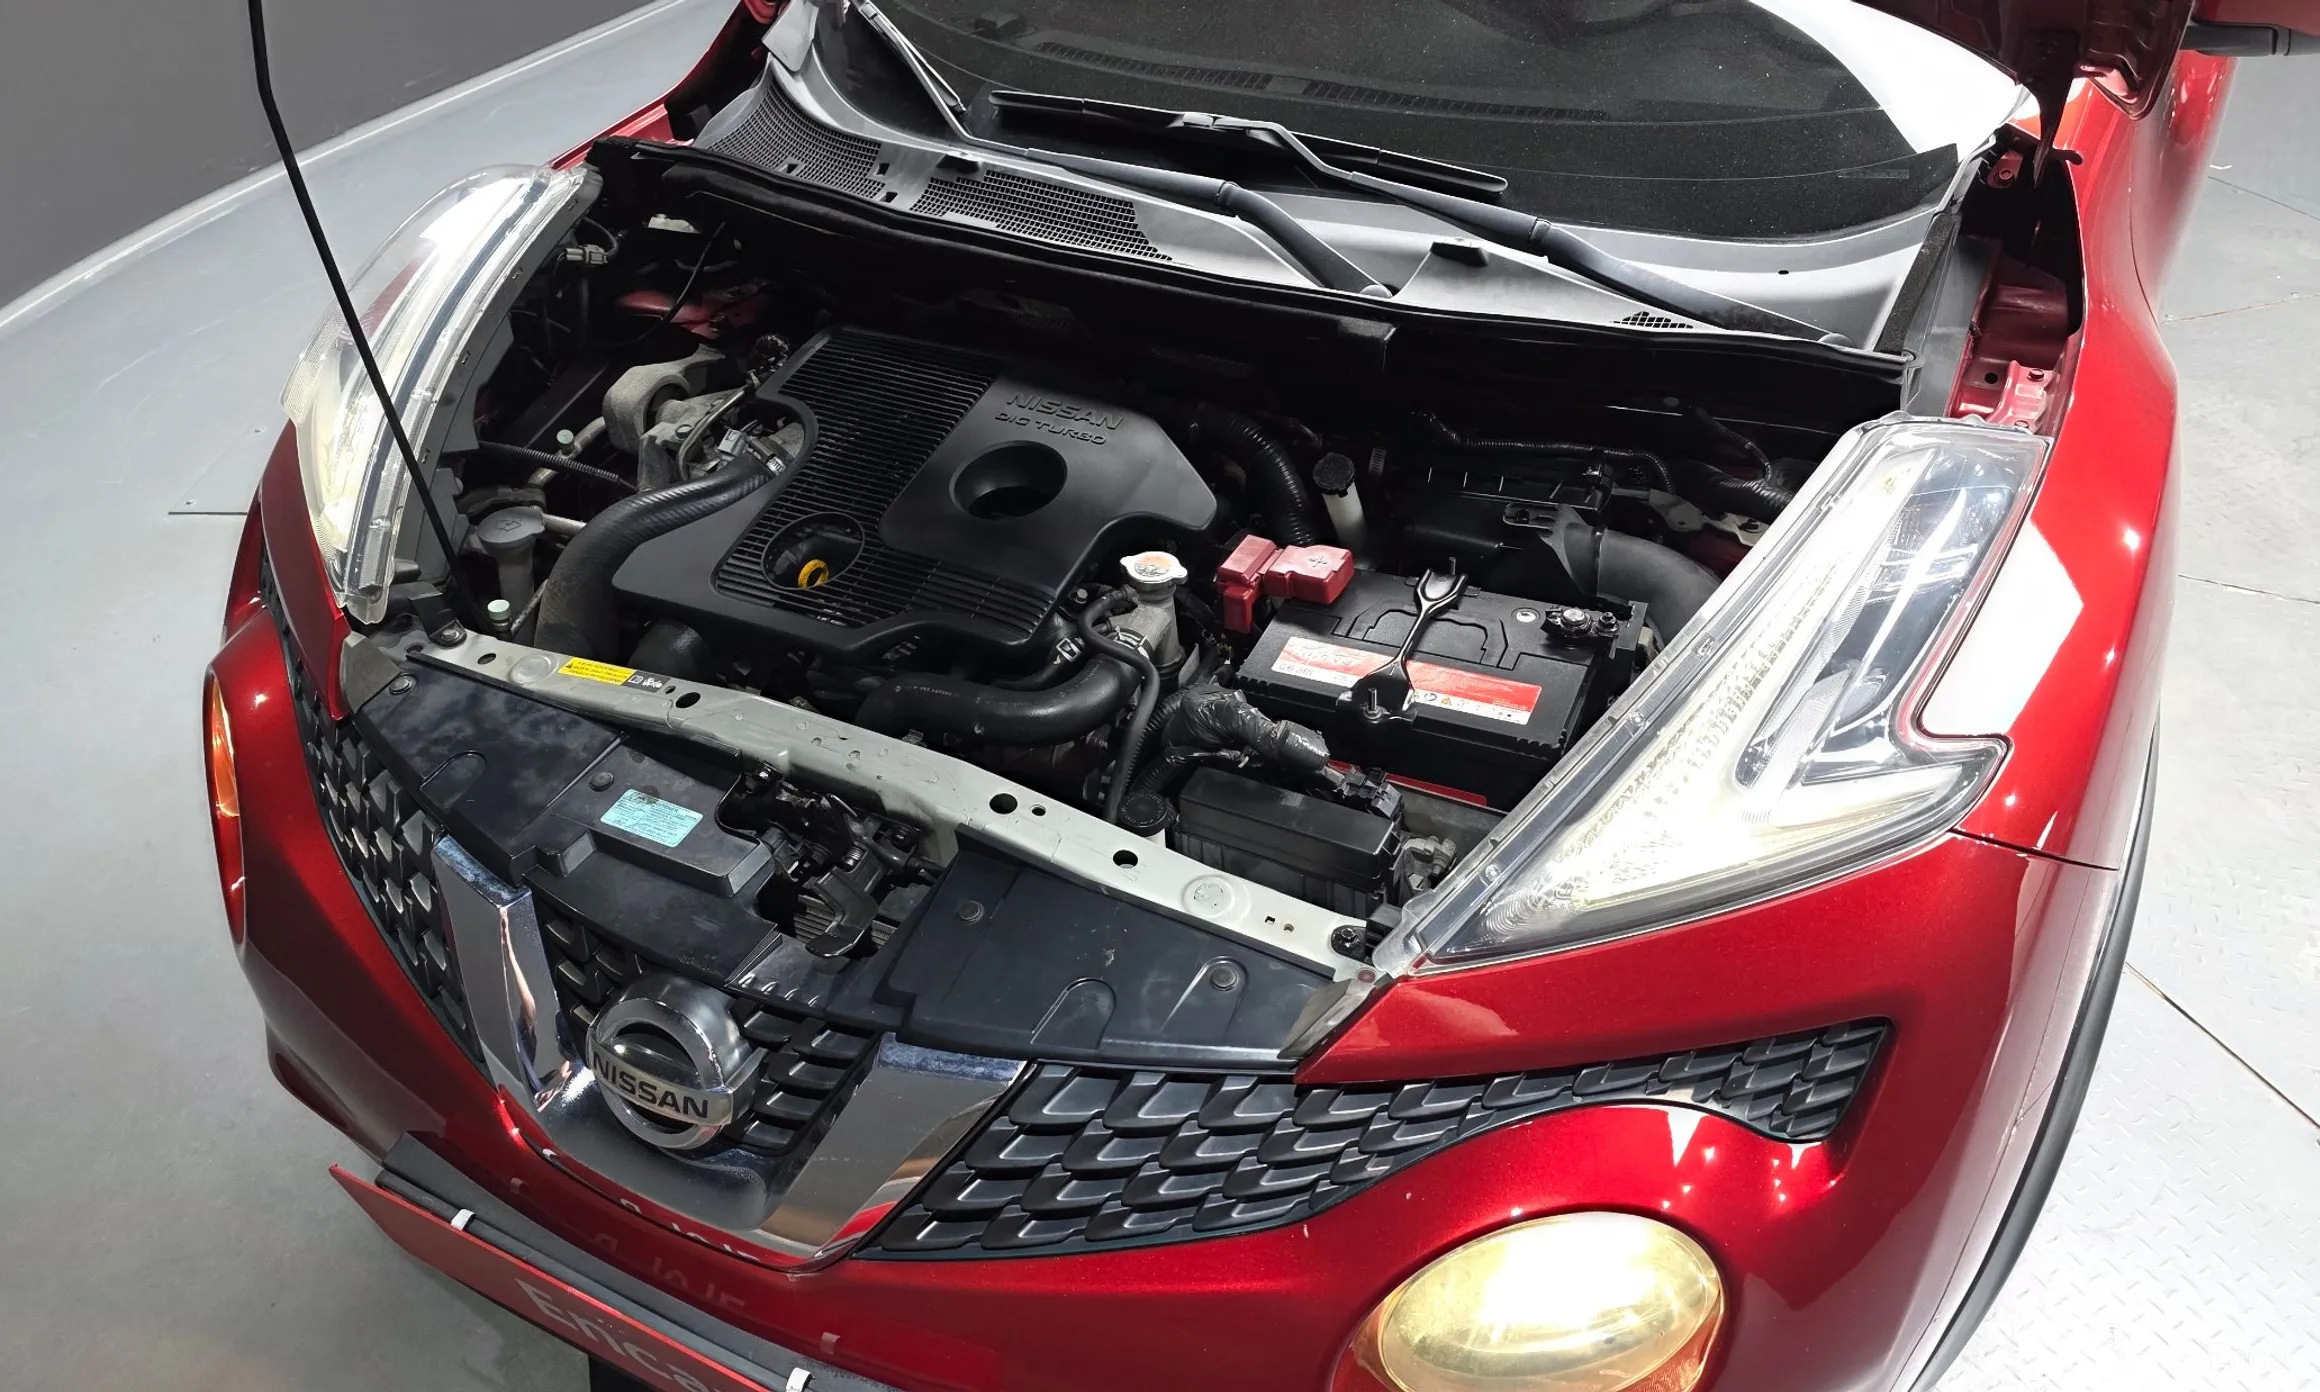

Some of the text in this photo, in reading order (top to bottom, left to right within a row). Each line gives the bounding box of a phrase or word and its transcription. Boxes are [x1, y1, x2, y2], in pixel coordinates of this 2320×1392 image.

[995, 412, 1106, 445] DIG TURBO
[1006, 391, 1123, 430] NISSAN
[593, 1051, 708, 1119] NISSAN
[515, 1278, 722, 1392] Enca
